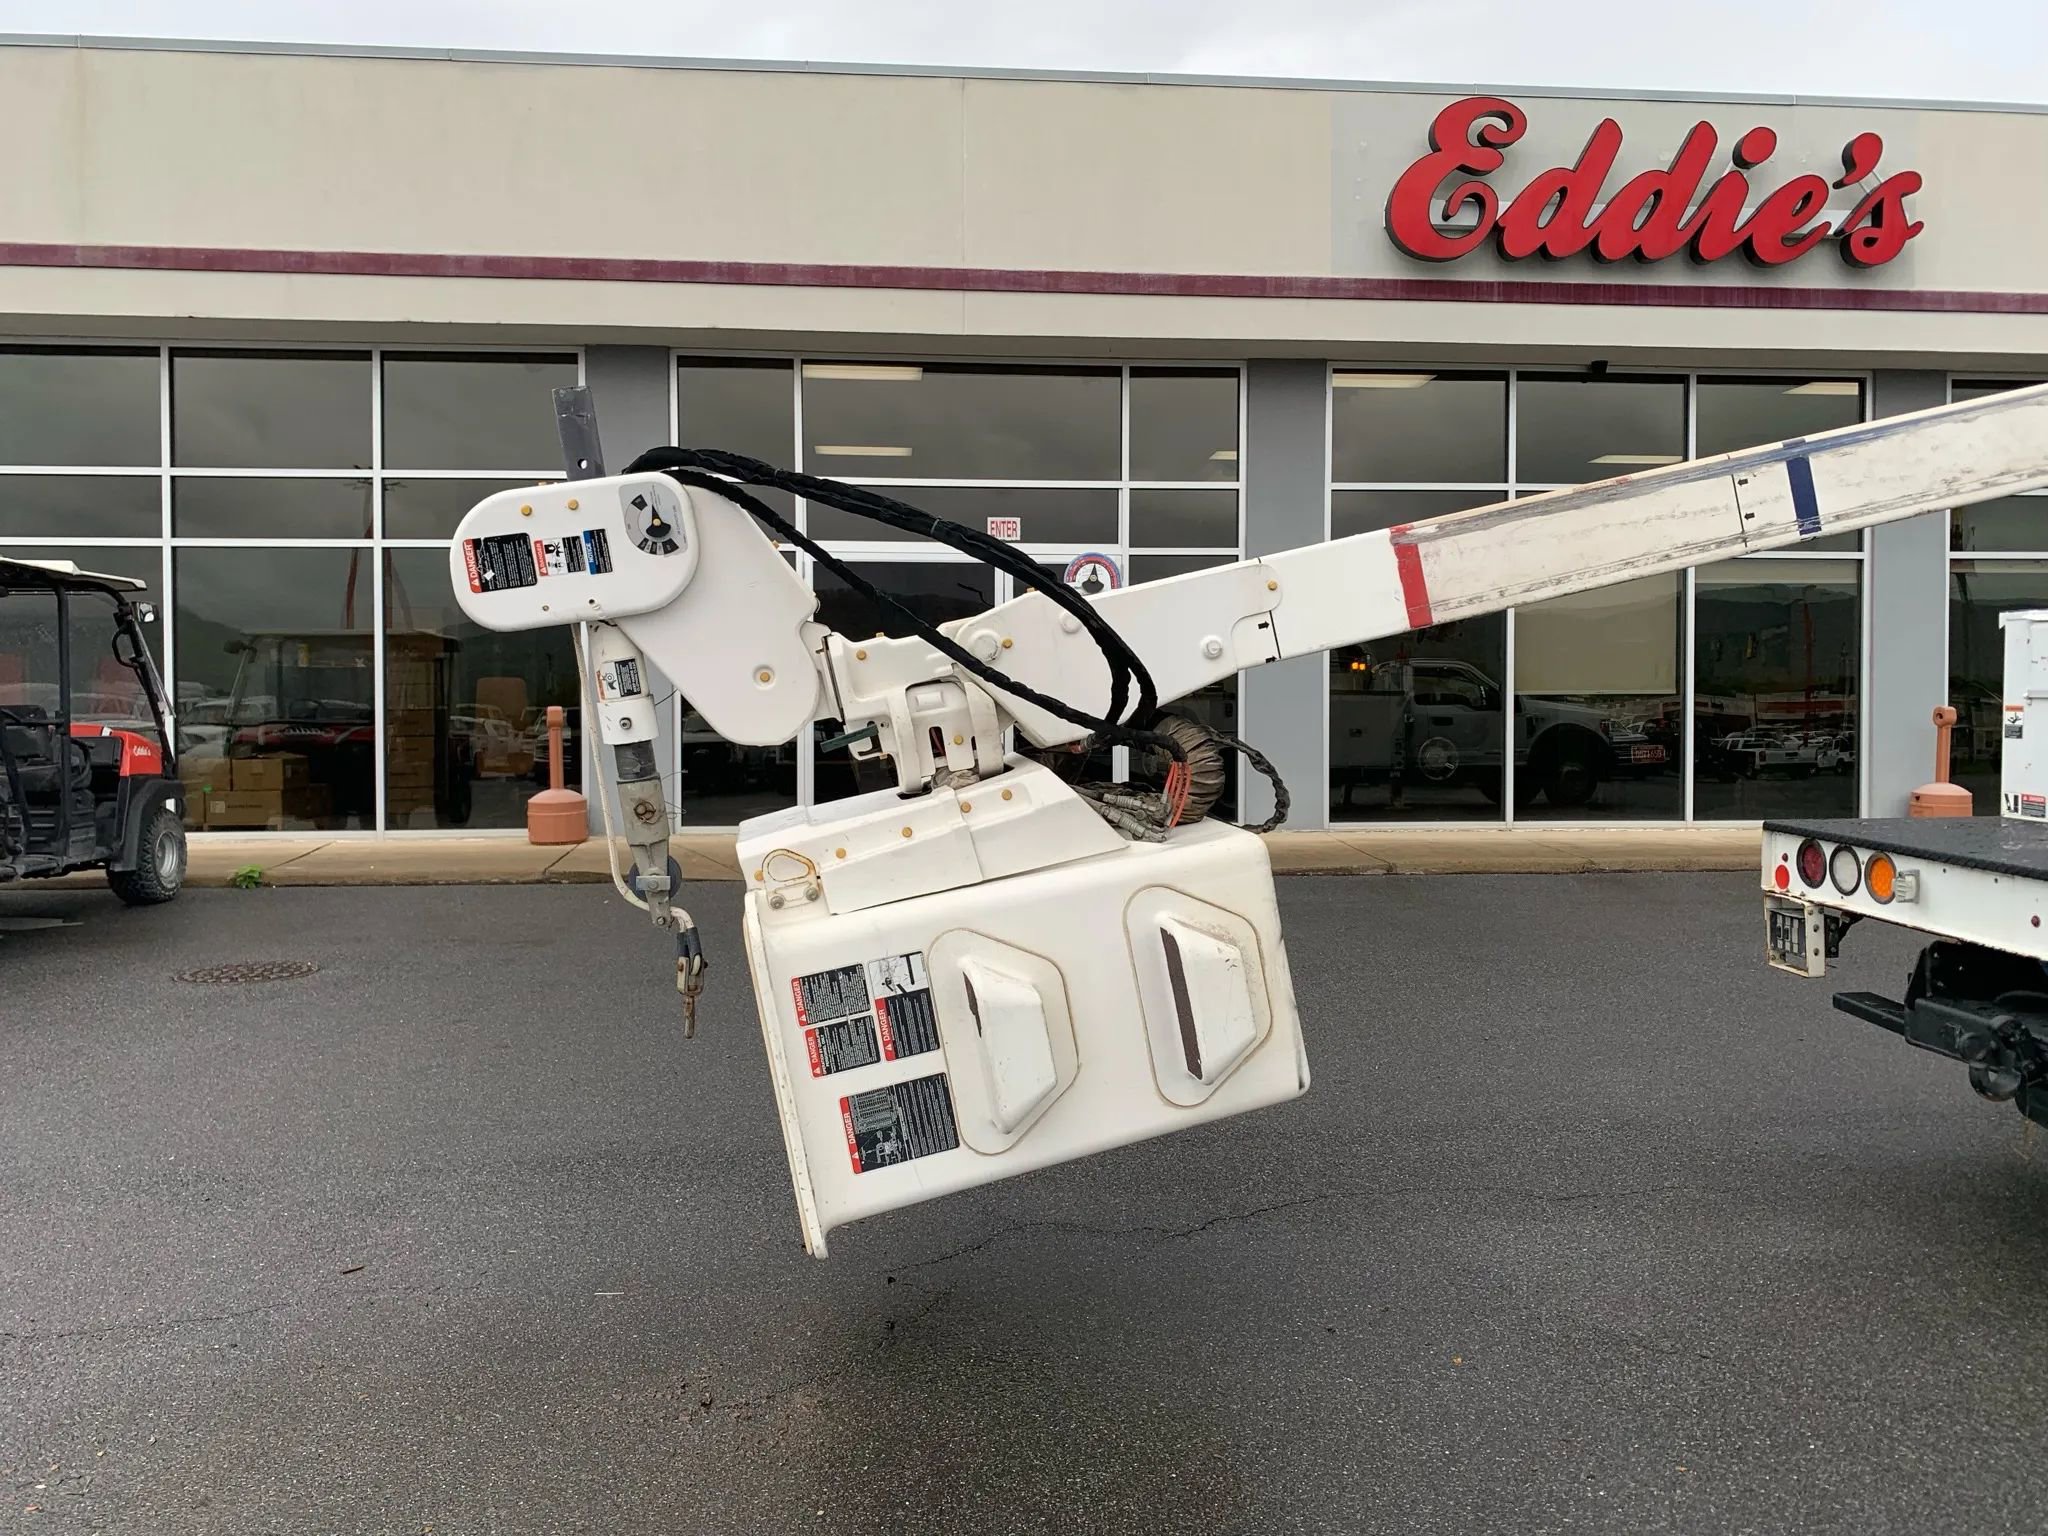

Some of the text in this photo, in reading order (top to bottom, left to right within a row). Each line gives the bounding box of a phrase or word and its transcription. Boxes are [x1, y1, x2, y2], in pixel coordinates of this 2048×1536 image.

[1385, 97, 1923, 268] Eddie's
[991, 521, 1017, 538] ENTER
[466, 543, 477, 578] DANGER
[538, 542, 546, 566] DANGER
[793, 981, 804, 1012] DANGER
[878, 1009, 890, 1042] DANGER
[808, 1036, 818, 1063] DANGER
[844, 1113, 855, 1144] DANGER
